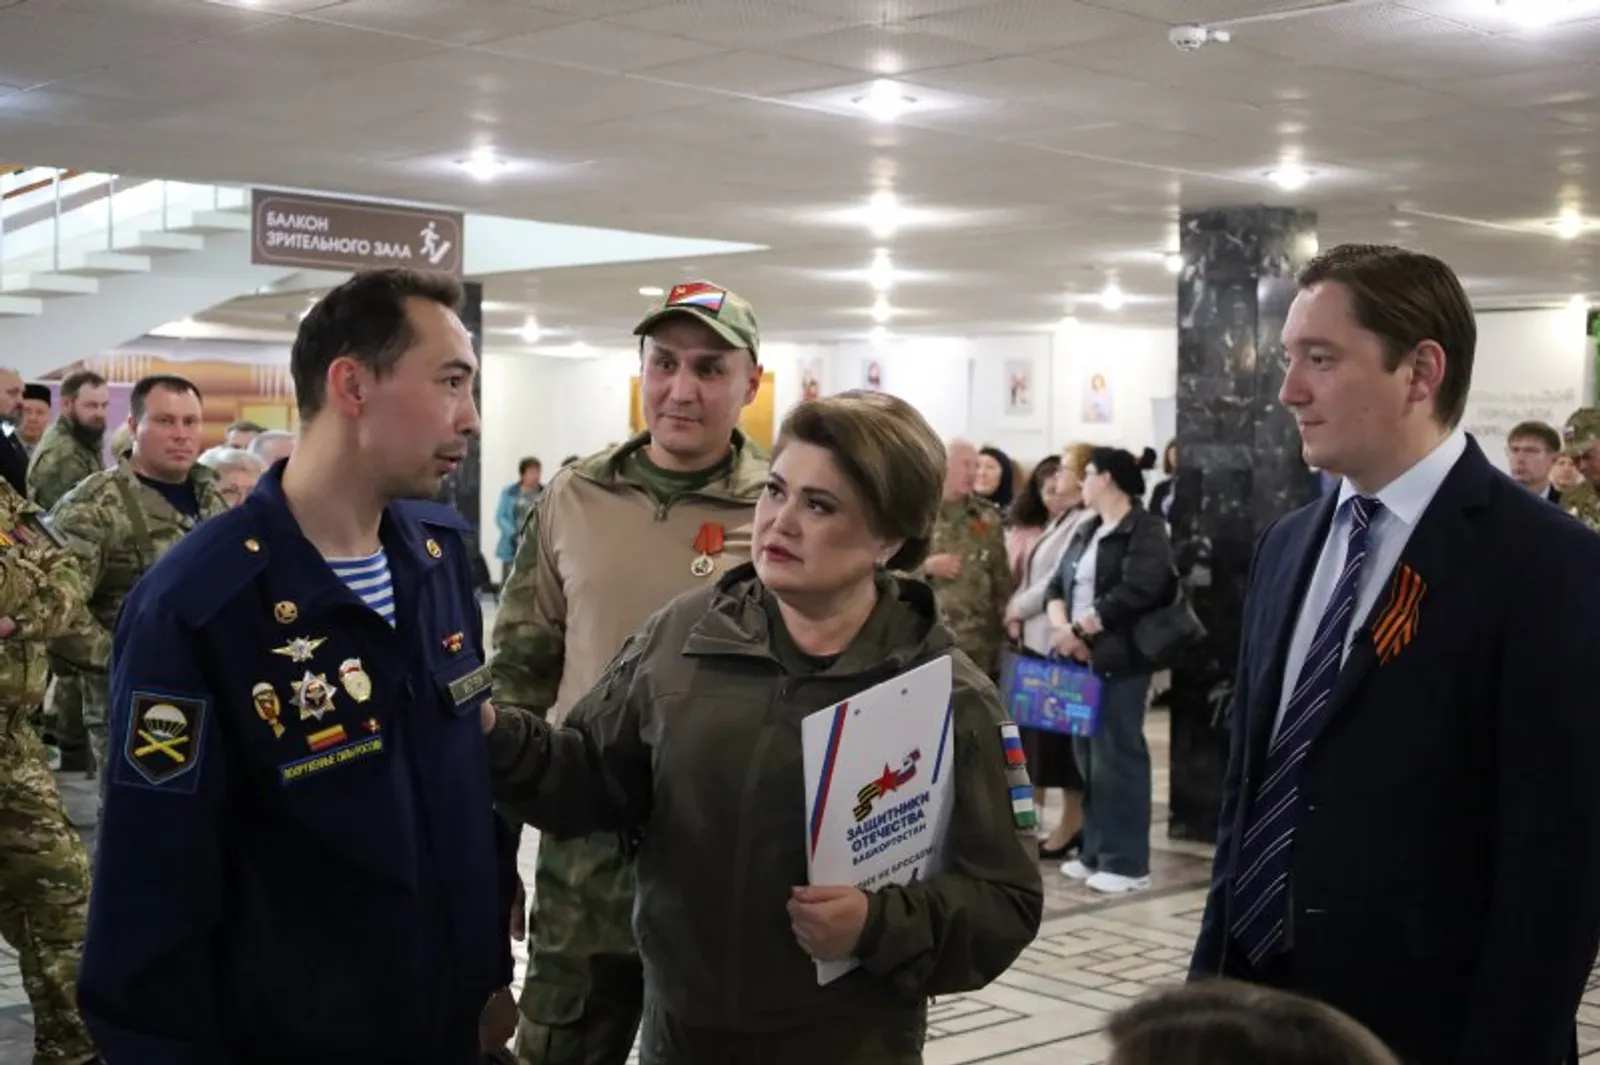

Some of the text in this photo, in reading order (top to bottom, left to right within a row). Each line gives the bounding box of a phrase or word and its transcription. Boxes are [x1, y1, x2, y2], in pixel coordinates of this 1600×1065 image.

[266, 210, 329, 232] БАЛКОН
[266, 231, 412, 259] ЗРИТЕЛЬНОГО ЗАЛА
[847, 790, 930, 841] ЗАЩИТНИКИ
[851, 808, 925, 852] ОТЕЧЕСТВА
[852, 823, 927, 866] БАШКОРТОСТАН
